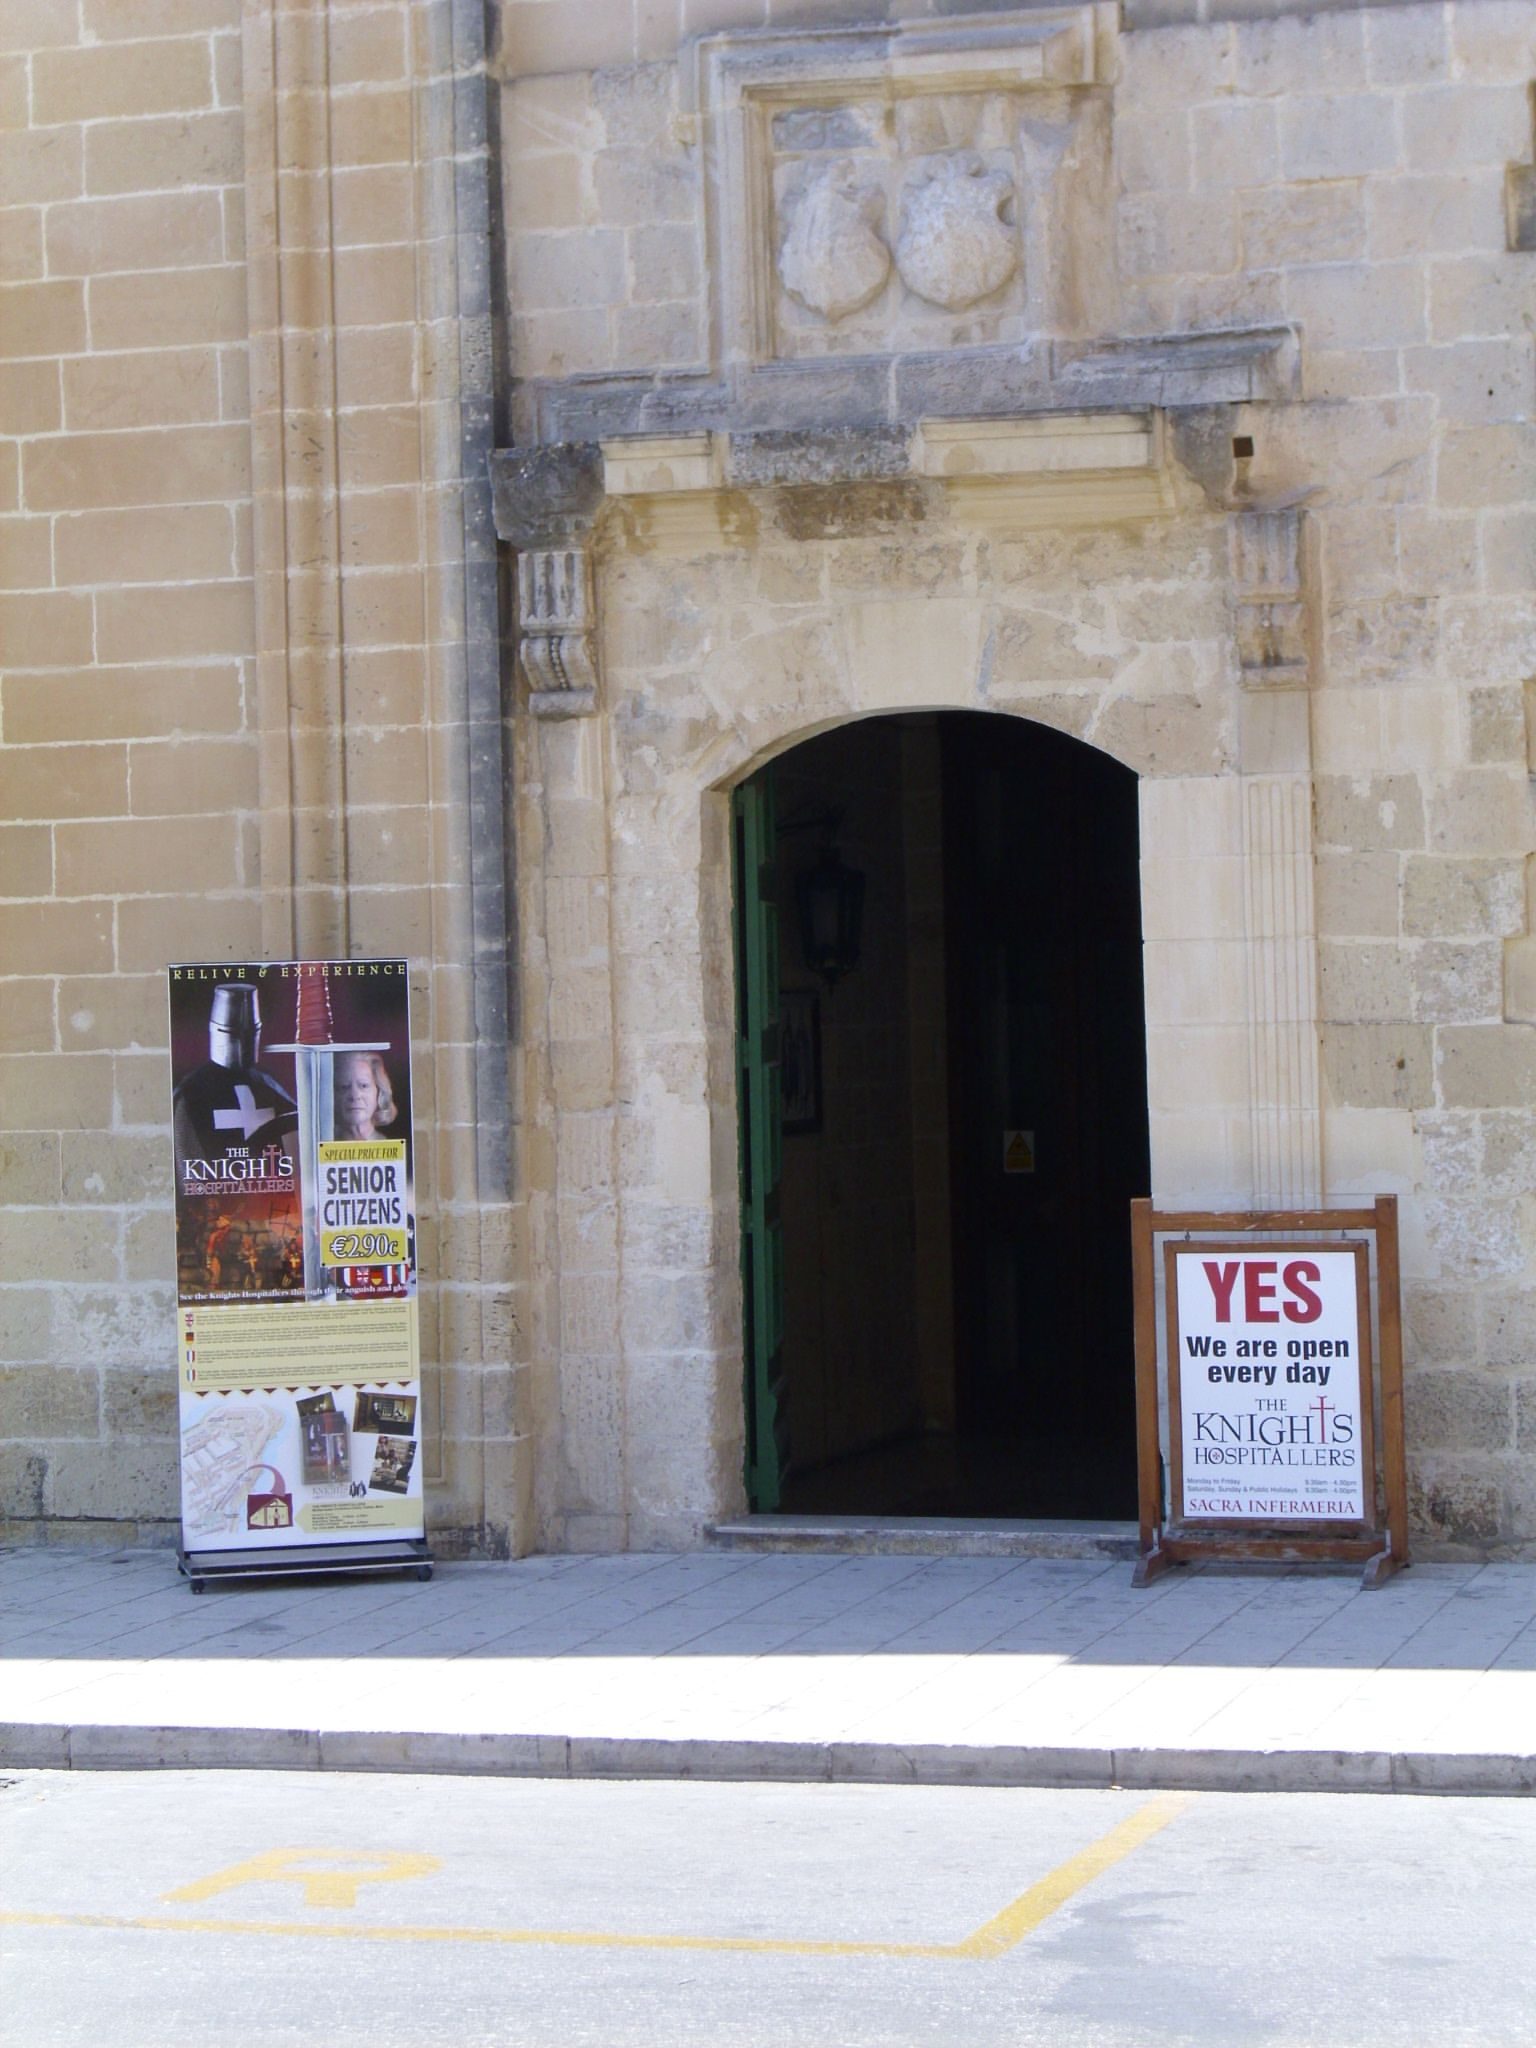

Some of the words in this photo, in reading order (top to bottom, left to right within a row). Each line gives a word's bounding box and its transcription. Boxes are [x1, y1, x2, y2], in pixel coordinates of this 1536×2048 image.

[173, 967, 245, 979] RELIVE
[258, 967, 268, 978] &
[281, 964, 406, 977] EXPERIENCE
[183, 1144, 294, 1180] KNIGHTS
[225, 1147, 249, 1158] THE
[323, 1148, 355, 1161] SPECIAL
[358, 1147, 380, 1160] PRICE
[382, 1146, 398, 1159] FOR
[183, 1179, 295, 1196] HOSPITALLERS
[326, 1165, 397, 1194] SENIOR
[324, 1197, 401, 1227] CITIZENS
[330, 1233, 399, 1259] €2.90c
[195, 1292, 209, 1300] the
[209, 1290, 241, 1301] Knights
[242, 1288, 289, 1299] Hospitallers
[377, 1284, 392, 1292] and
[1202, 1260, 1323, 1324] YES
[1186, 1336, 1227, 1358] We
[1236, 1339, 1278, 1358] are
[1287, 1339, 1350, 1361] open
[1208, 1364, 1277, 1386] every
[1286, 1361, 1331, 1386] day
[1255, 1398, 1288, 1412] THE
[1192, 1395, 1354, 1446] KNIGHTS
[1193, 1446, 1356, 1467] HOSPITALLERS
[1186, 1477, 1212, 1486] Monday
[1220, 1477, 1241, 1486] Friday
[1218, 1485, 1242, 1495] Sunday
[1249, 1486, 1270, 1494] Public
[1270, 1486, 1298, 1495] Holidays
[1189, 1499, 1243, 1513] SACRA
[1249, 1500, 1356, 1513] INFERMERIA
